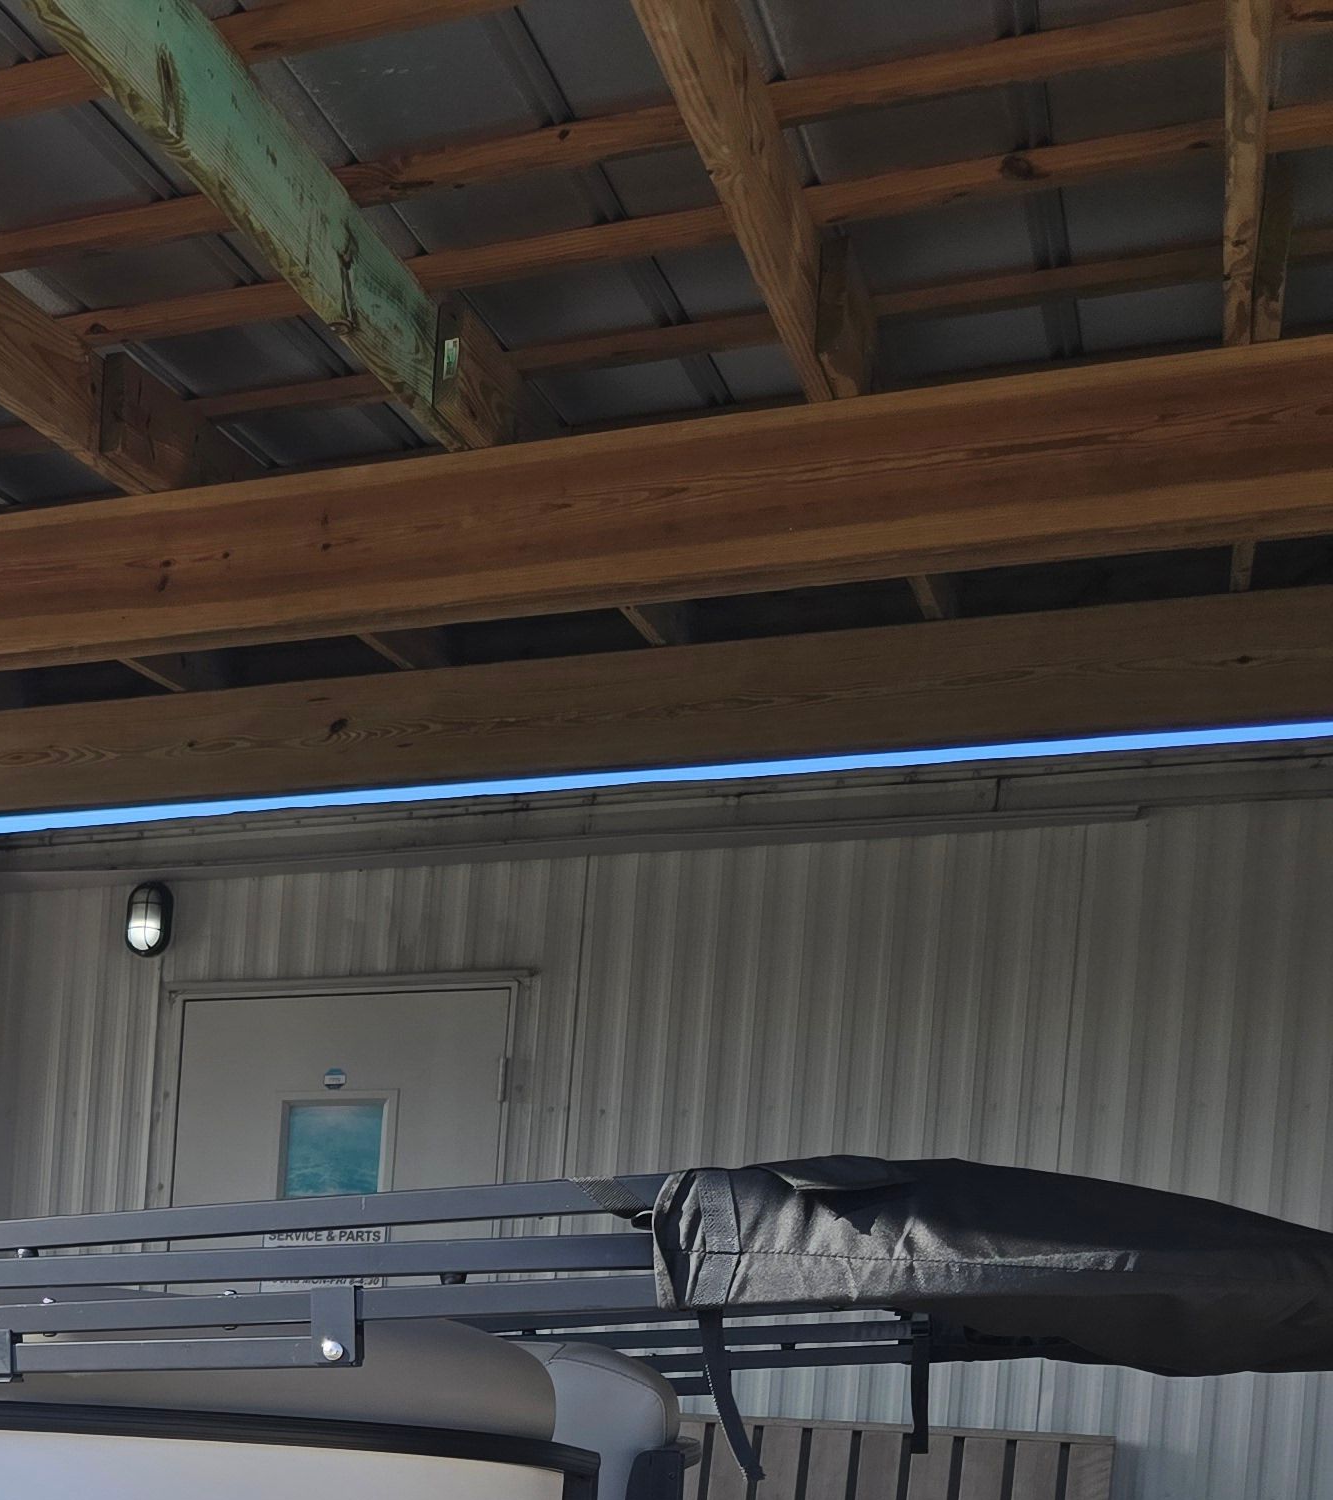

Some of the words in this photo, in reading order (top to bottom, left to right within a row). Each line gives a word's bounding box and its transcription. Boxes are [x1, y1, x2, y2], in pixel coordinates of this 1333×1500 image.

[268, 1230, 323, 1242] SERVICE
[326, 1230, 335, 1242] &
[338, 1229, 382, 1243] PARTS
